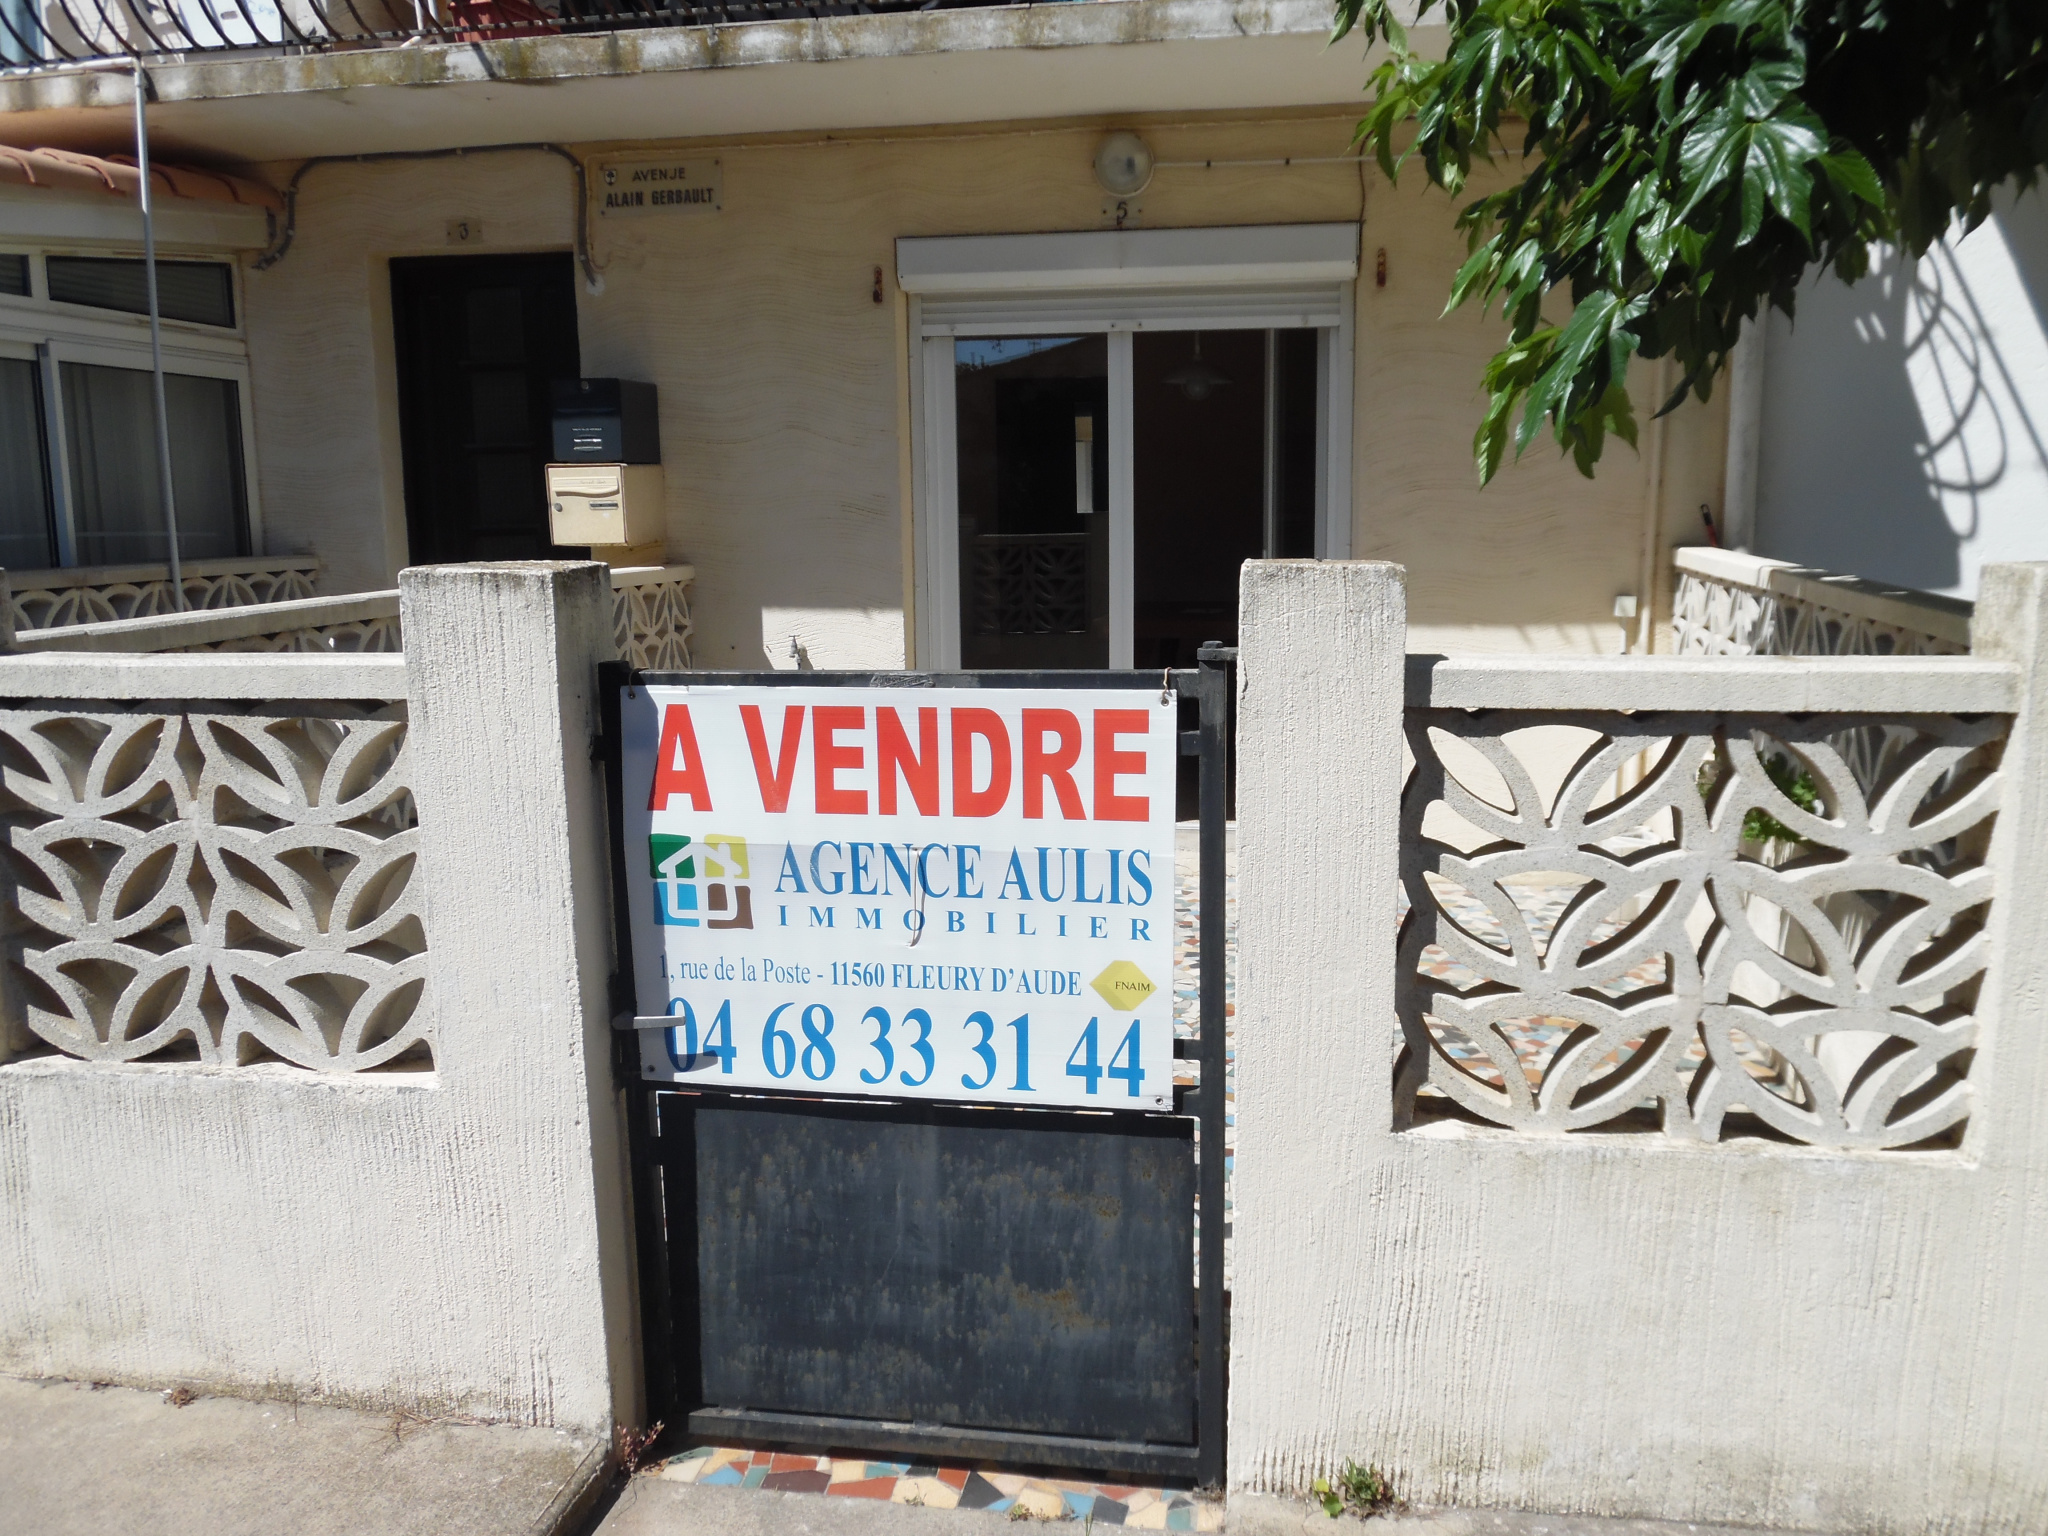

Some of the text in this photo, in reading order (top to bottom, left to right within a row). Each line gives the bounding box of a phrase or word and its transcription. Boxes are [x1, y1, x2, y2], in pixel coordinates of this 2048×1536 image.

[605, 187, 714, 208] ALAIN GERBAULT
[647, 704, 1149, 822] A VENDRE
[774, 840, 1153, 906] AGENCE AULIS
[777, 905, 1152, 942] IMMOBILIER
[659, 954, 675, 983] 1,
[680, 962, 709, 980] rue
[714, 956, 735, 981] de
[741, 957, 757, 982] la
[762, 958, 811, 984] Poste
[830, 961, 885, 988] 11560
[891, 963, 985, 992] FLEURY
[1114, 980, 1151, 992] FNAIM
[664, 996, 1146, 1097] 04 68 33 31 44
